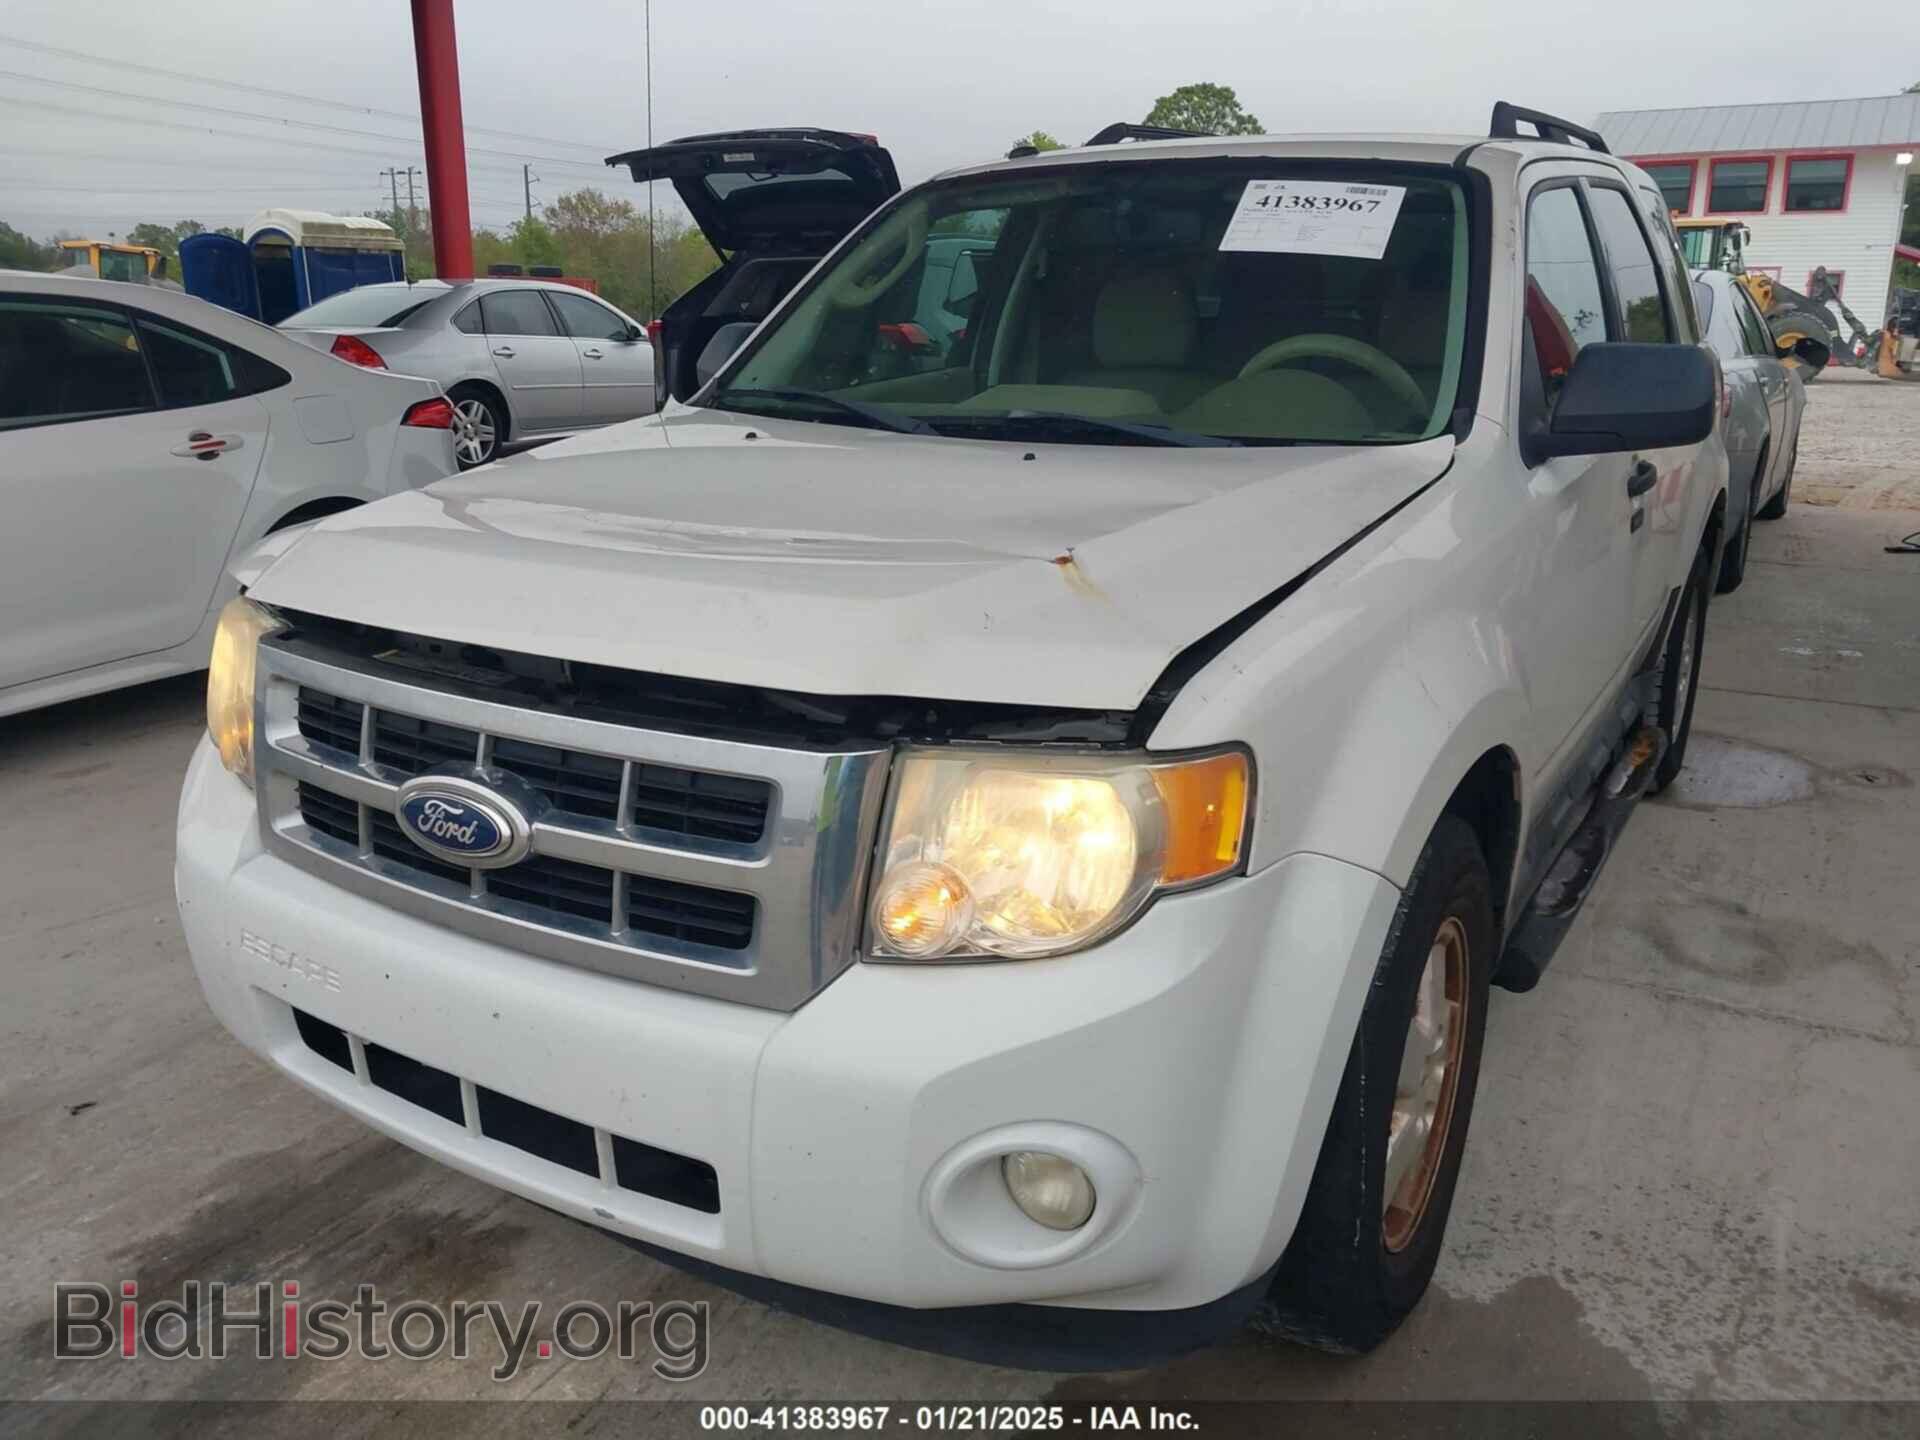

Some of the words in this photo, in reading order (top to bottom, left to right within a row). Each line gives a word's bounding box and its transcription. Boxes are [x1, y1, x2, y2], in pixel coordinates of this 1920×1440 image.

[1255, 194, 1381, 214] 41383967
[417, 799, 479, 844] Ford
[240, 927, 343, 993] ESCAPE
